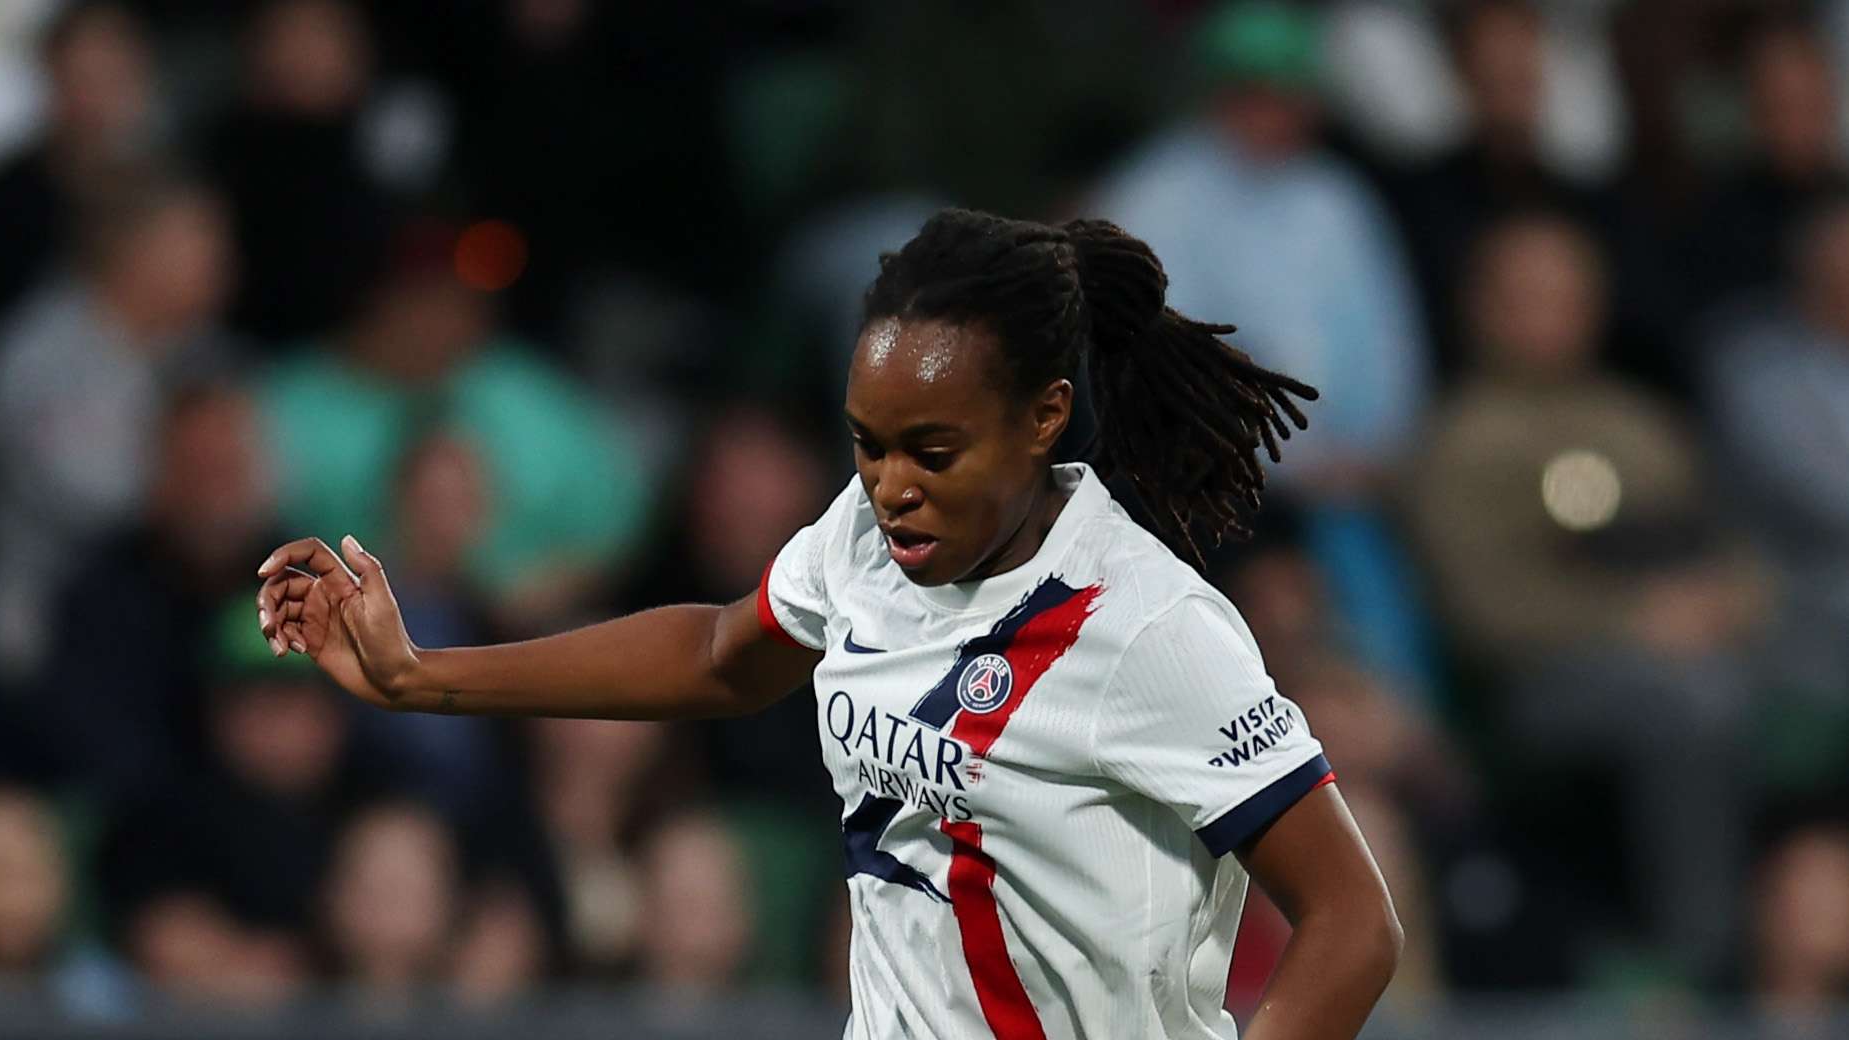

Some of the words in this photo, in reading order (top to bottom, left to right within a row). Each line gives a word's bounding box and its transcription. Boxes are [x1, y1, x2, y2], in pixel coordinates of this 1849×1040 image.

[976, 656, 1008, 677] PARIS
[826, 690, 966, 792] QATAR
[1218, 694, 1275, 742] VISIT
[858, 758, 973, 821] AIRWAYS
